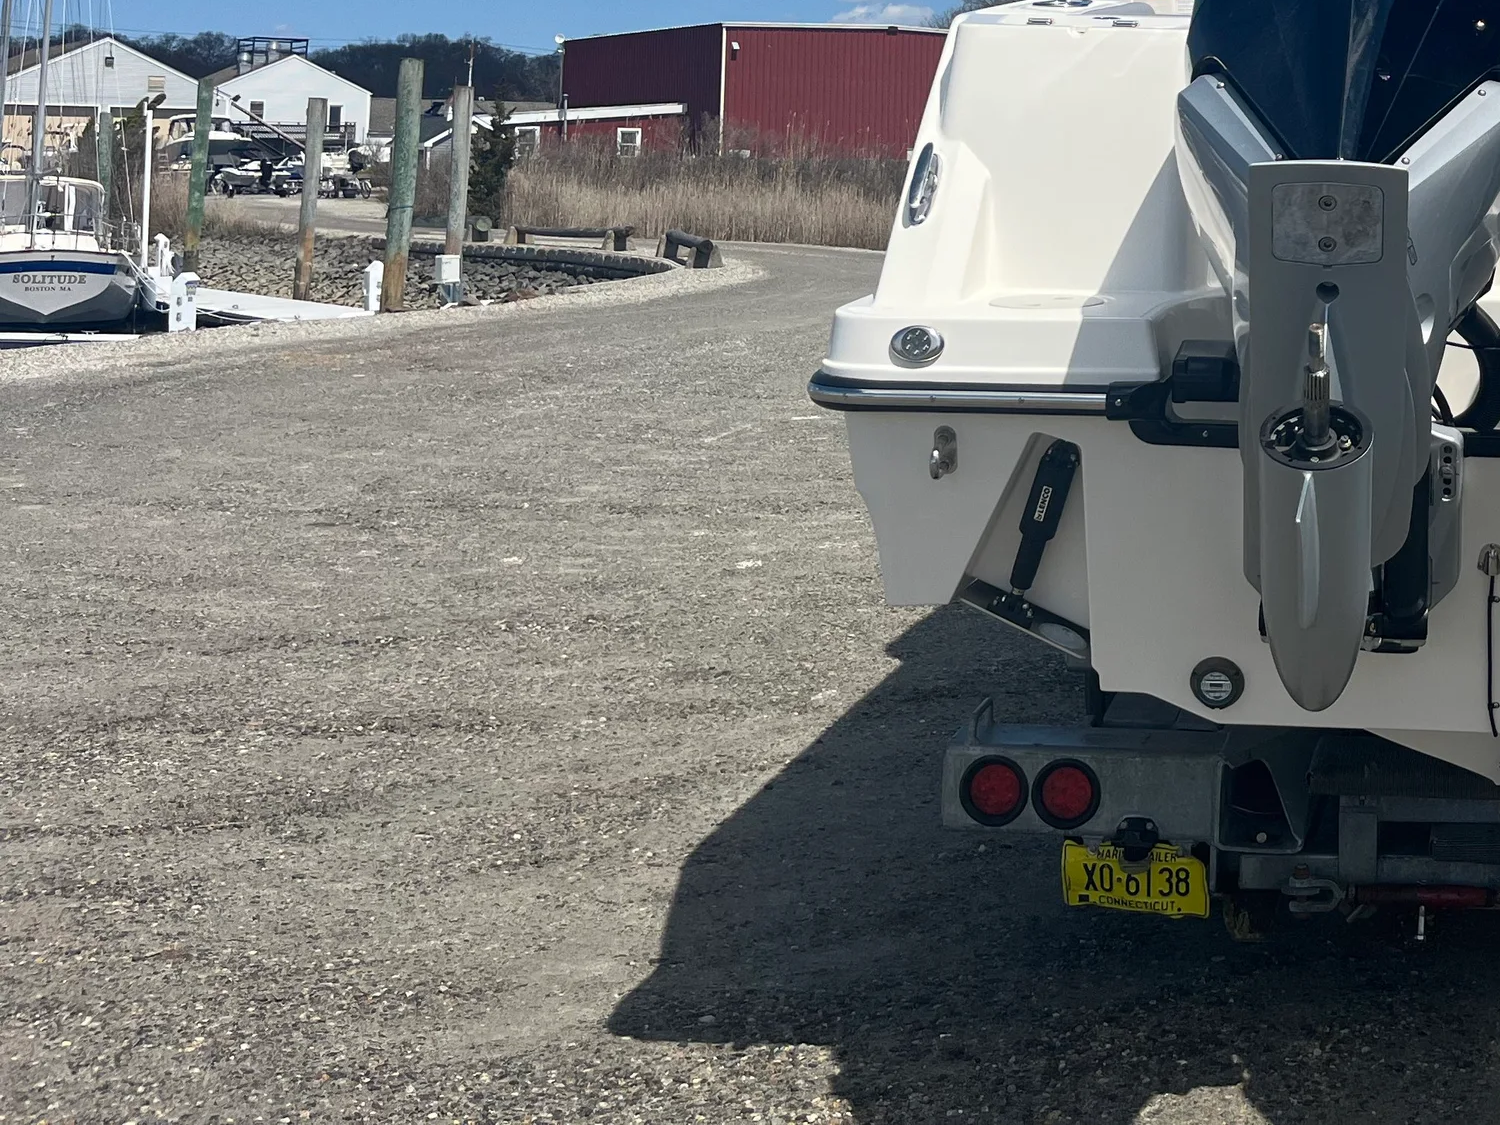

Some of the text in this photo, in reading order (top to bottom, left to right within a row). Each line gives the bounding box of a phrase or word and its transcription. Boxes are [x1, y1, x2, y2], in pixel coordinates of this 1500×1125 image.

[12, 274, 87, 285] SOLITUDE
[1038, 488, 1050, 513] LENCO
[1098, 848, 1177, 862] MARI AILER
[1099, 895, 1175, 911] CONNECTICUT
